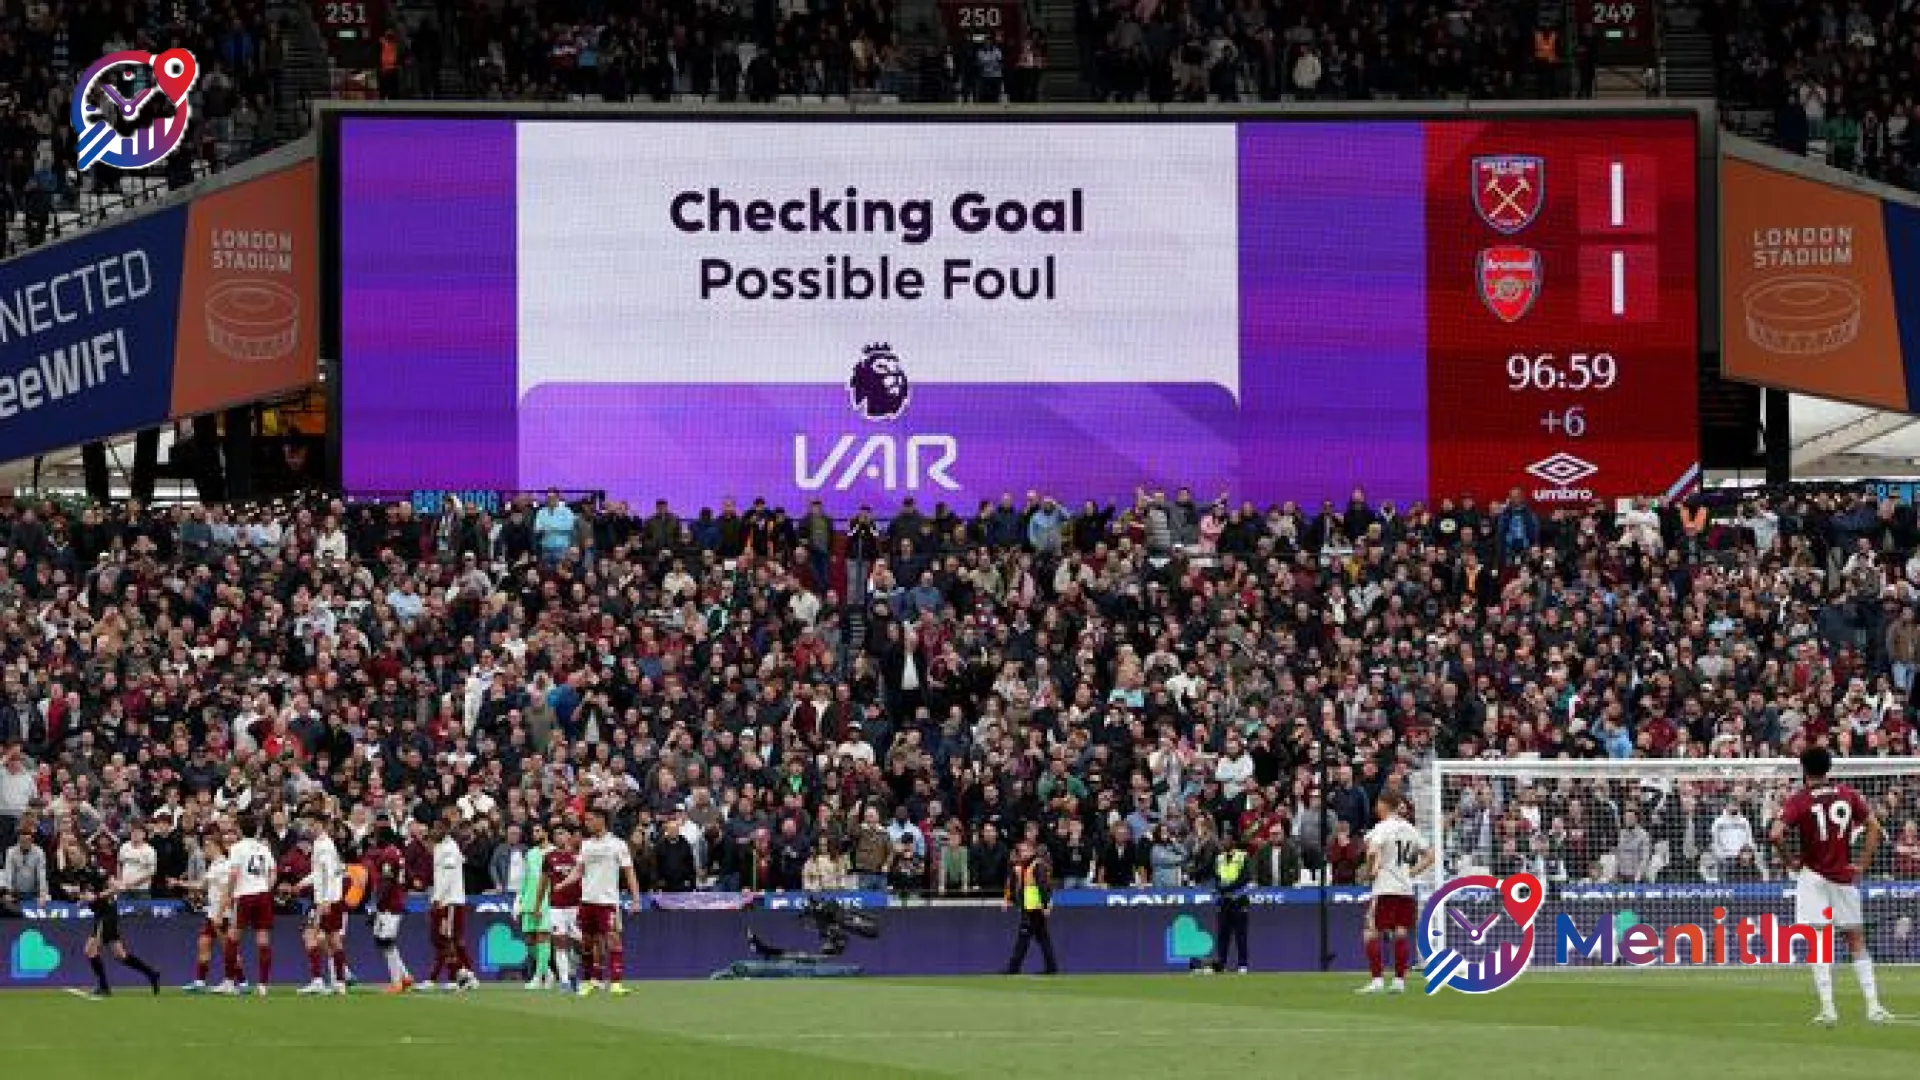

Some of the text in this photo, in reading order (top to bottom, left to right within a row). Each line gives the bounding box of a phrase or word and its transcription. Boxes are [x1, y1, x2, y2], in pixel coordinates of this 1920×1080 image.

[326, 2, 366, 24] 251
[959, 7, 1001, 27] 250
[1594, 3, 1635, 24] 249
[670, 187, 1083, 243] Checking Goal
[211, 229, 292, 251] LONDON
[1754, 227, 1852, 247] LONDON
[212, 250, 292, 272] STADIUM
[1753, 247, 1852, 268] STADIUM
[700, 255, 1055, 300] Possible Foul
[1507, 353, 1617, 390] 96:59
[1540, 407, 1586, 437] +6
[795, 435, 959, 491] VAR
[1532, 486, 1594, 501] umbro
[1811, 800, 1851, 841] 19
